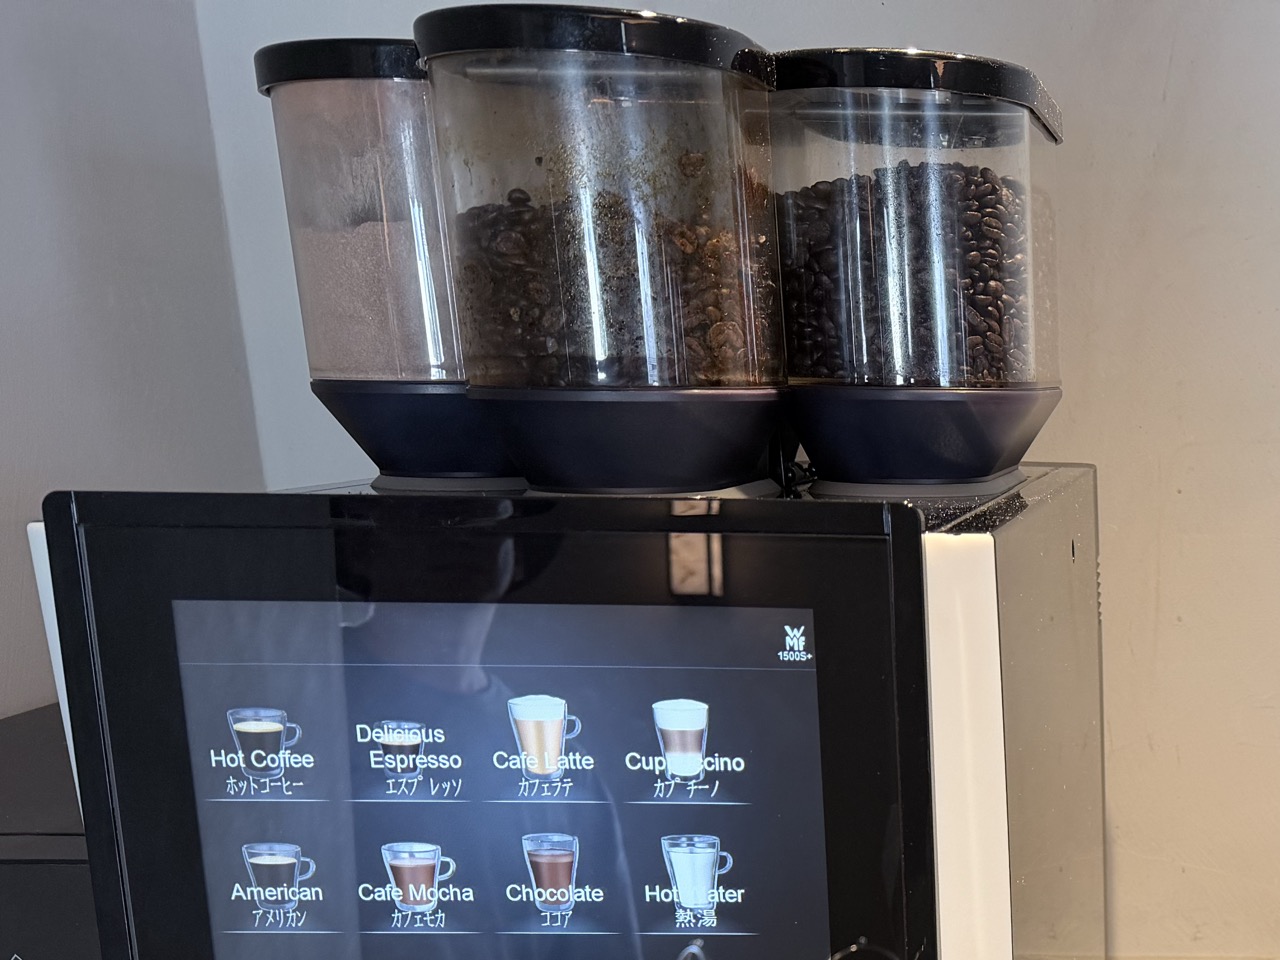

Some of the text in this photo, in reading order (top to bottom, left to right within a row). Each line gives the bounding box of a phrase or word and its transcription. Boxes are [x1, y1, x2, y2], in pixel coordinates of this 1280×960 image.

[784, 625, 806, 651] WMF
[777, 651, 813, 661] 1500S+
[355, 724, 445, 743] Delicious
[209, 749, 315, 768] Hot Coffee
[368, 750, 463, 773] Espresso
[492, 750, 595, 770] Cafe Latte
[624, 751, 746, 776] Cupcino
[226, 775, 305, 796] ホットコーヒー
[517, 777, 574, 798] カフェラテ
[230, 882, 324, 901] American
[358, 883, 475, 901] Cafe Mocha
[505, 883, 605, 902] Chocolate
[644, 884, 746, 902] Hot ater
[251, 909, 308, 928] アメリカン
[391, 908, 447, 928] カフェモカ
[540, 910, 574, 928] ココア
[674, 908, 718, 928] 熱湯
